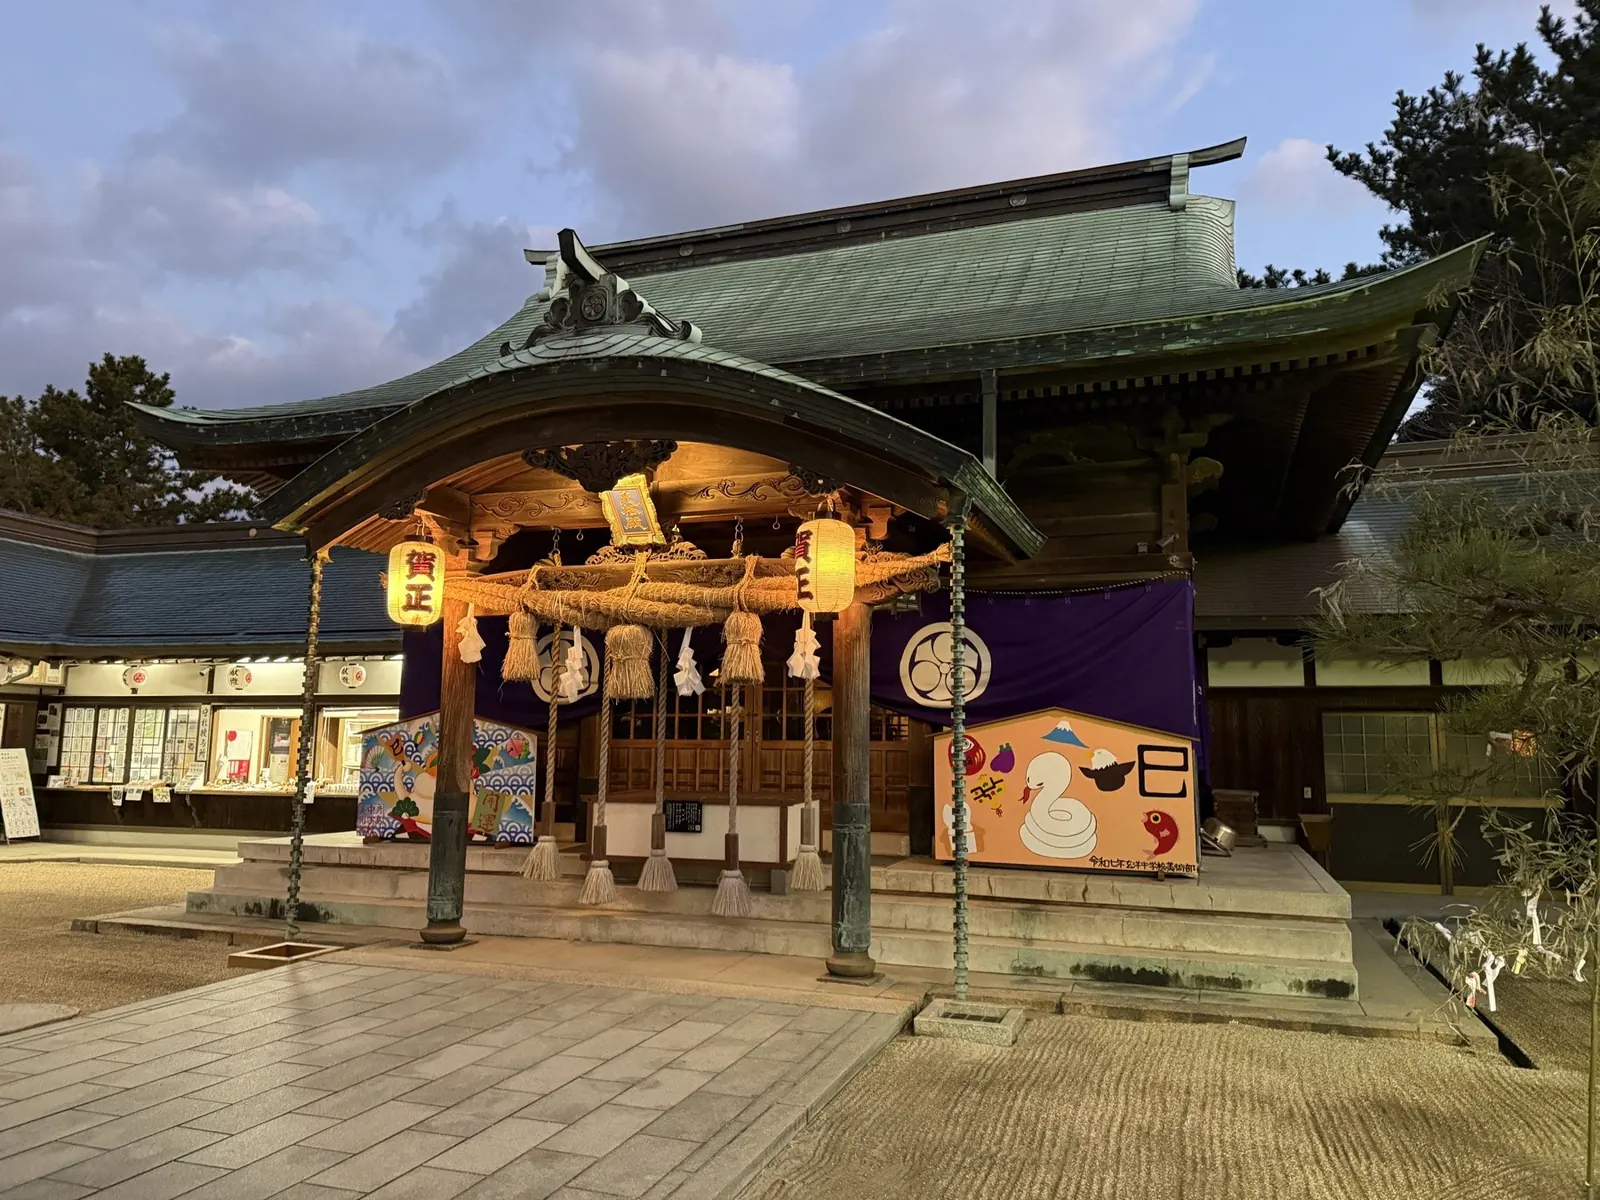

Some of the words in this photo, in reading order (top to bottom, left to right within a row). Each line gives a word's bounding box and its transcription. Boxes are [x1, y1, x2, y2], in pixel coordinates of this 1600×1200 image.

[401, 549, 437, 614] 賀正
[1137, 744, 1189, 798] 巳
[478, 791, 500, 832] 開運
